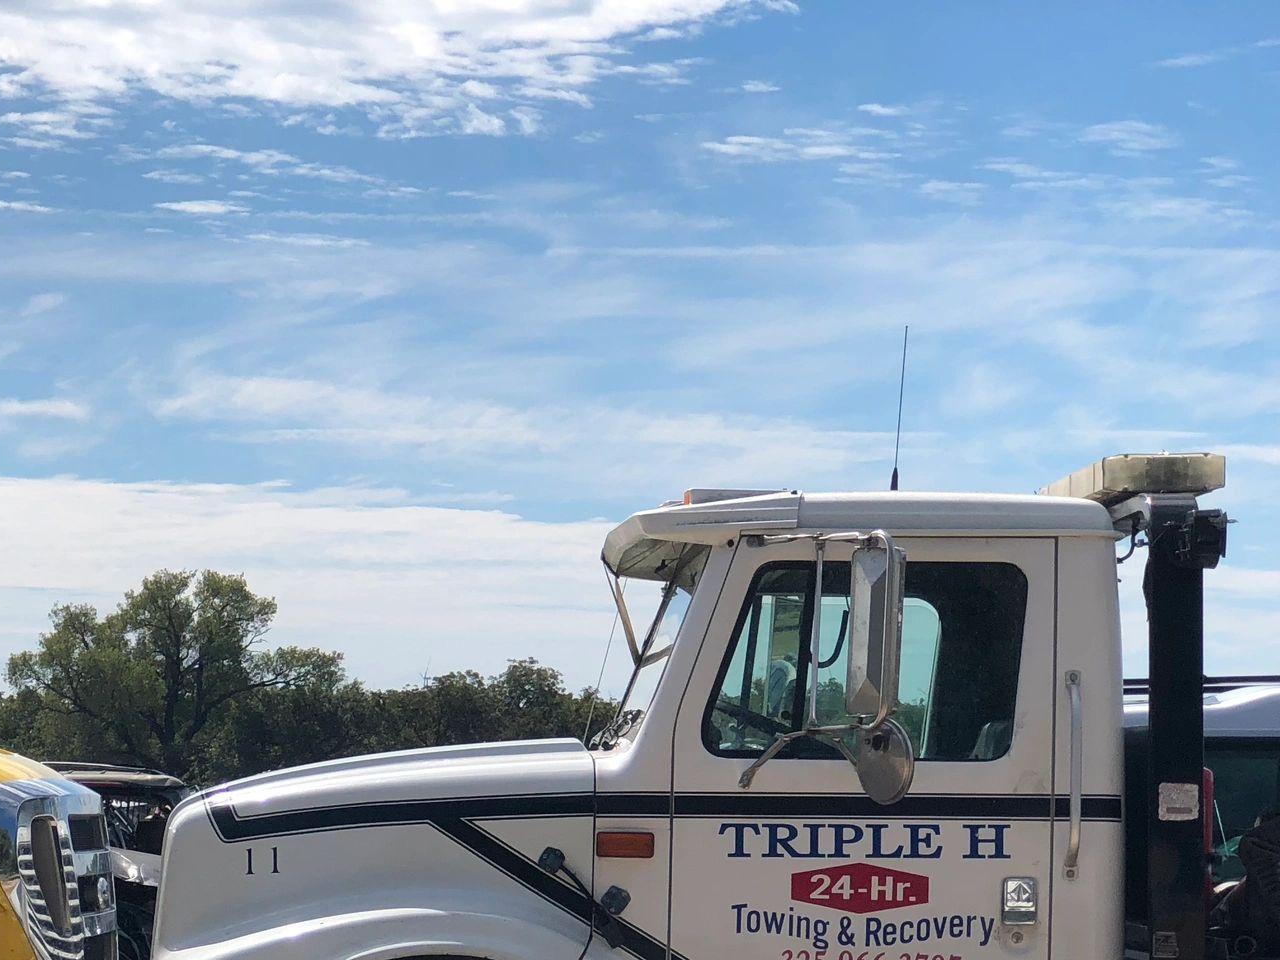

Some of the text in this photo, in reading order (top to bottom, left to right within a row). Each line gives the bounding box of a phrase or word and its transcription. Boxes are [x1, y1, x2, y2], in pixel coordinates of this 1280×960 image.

[718, 823, 1011, 859] TRIPLE H
[809, 874, 917, 902] 24-Hr.
[731, 904, 996, 949] Towing & Recovery
